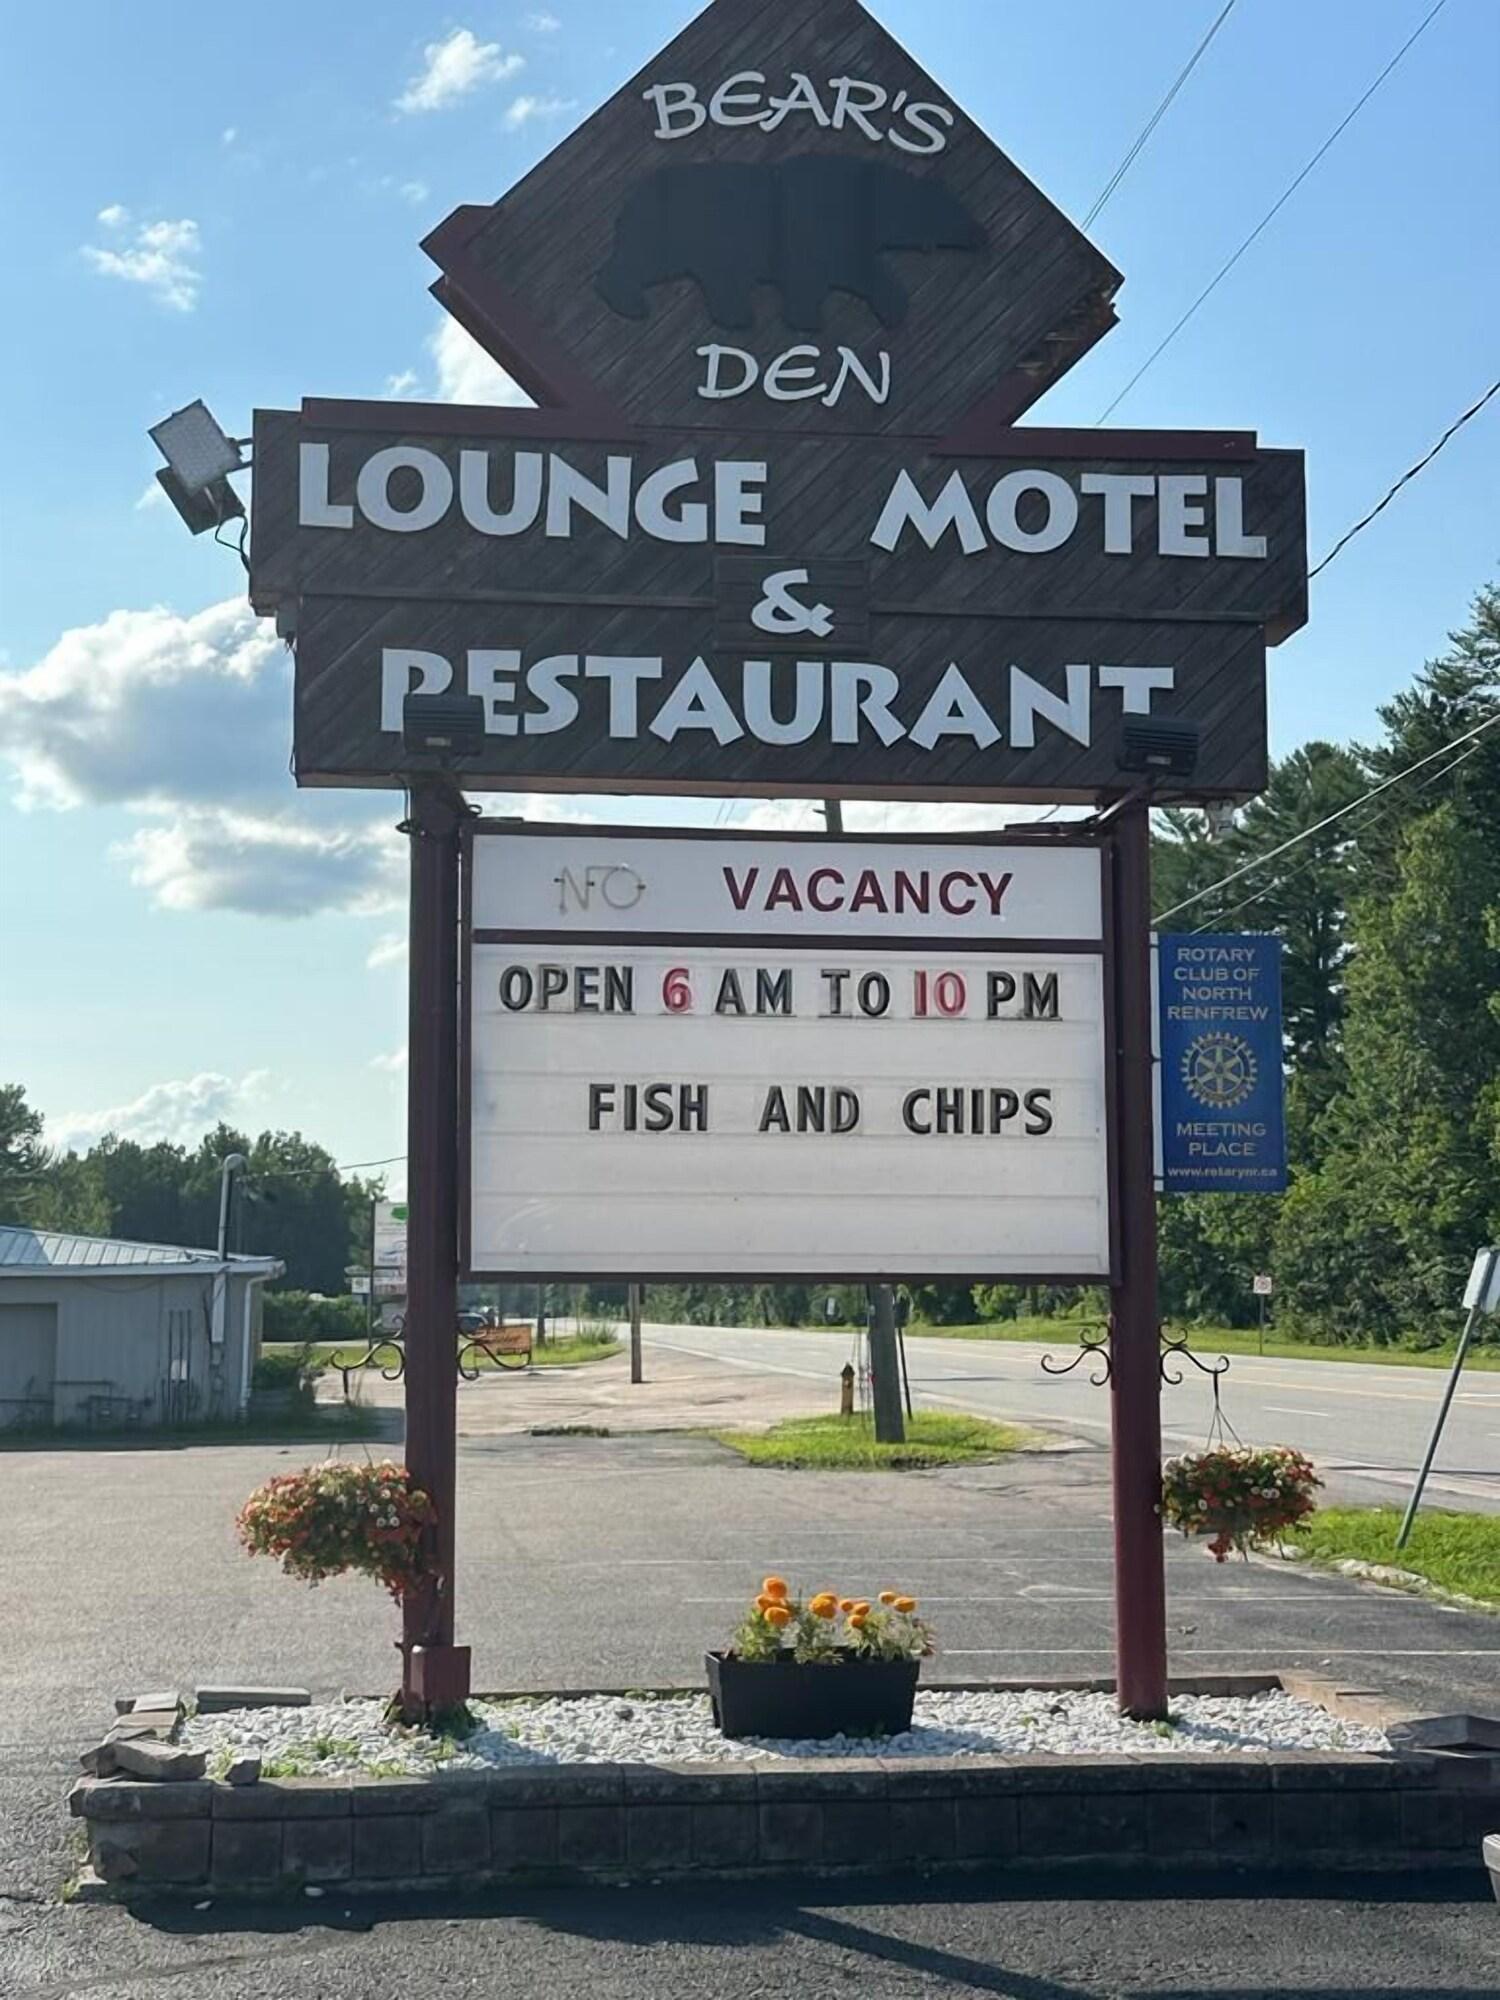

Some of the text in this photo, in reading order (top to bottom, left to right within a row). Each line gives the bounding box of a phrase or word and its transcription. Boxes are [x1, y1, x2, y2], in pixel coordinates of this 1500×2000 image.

[643, 71, 954, 153] BEAR'S
[696, 344, 890, 406] DEN
[300, 442, 1268, 559] LOUNGE MOTEL
[751, 568, 835, 637] &
[723, 866, 1013, 916] VACANCY
[1174, 967, 1261, 982] CLUB OF
[1177, 948, 1256, 962] ROTARY
[499, 963, 1059, 1019] OPEN 6 AM TO 10 PM
[1167, 1005, 1269, 1021] RENFREW
[1183, 986, 1253, 1001] NORTH
[588, 1083, 1054, 1136] FISH AND CHIPS
[1176, 1122, 1267, 1138] MEETING
[1188, 1142, 1258, 1157] PLACE
